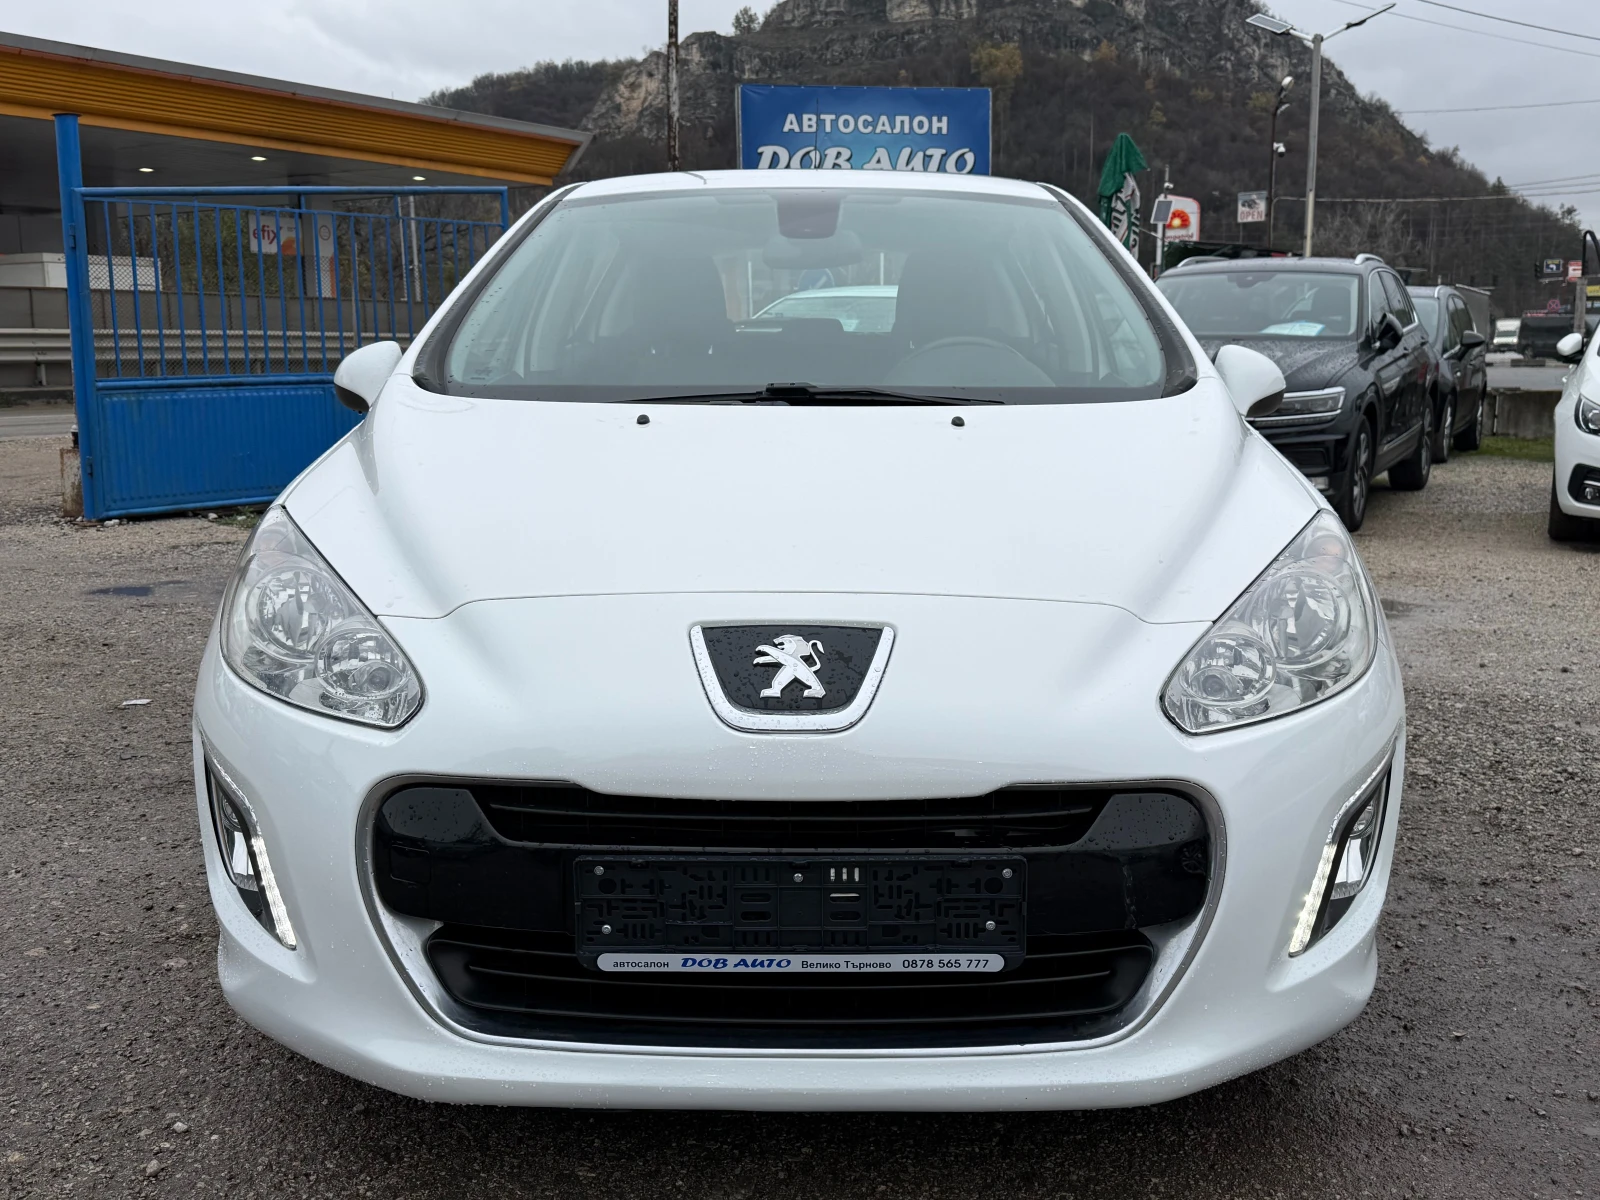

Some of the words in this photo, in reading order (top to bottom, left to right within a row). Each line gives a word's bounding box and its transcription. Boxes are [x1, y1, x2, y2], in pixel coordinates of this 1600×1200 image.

[782, 113, 948, 135] АВТОСАЛОН
[863, 147, 975, 174] AUTO
[1240, 210, 1263, 220] OPEN
[612, 960, 670, 969] автосалон
[680, 957, 729, 969] DOB
[733, 958, 792, 969] AUTO
[801, 960, 841, 969] Велико
[844, 960, 892, 971] Търново
[902, 959, 934, 969] 0878
[937, 959, 962, 969] 565
[966, 959, 990, 969] 777
